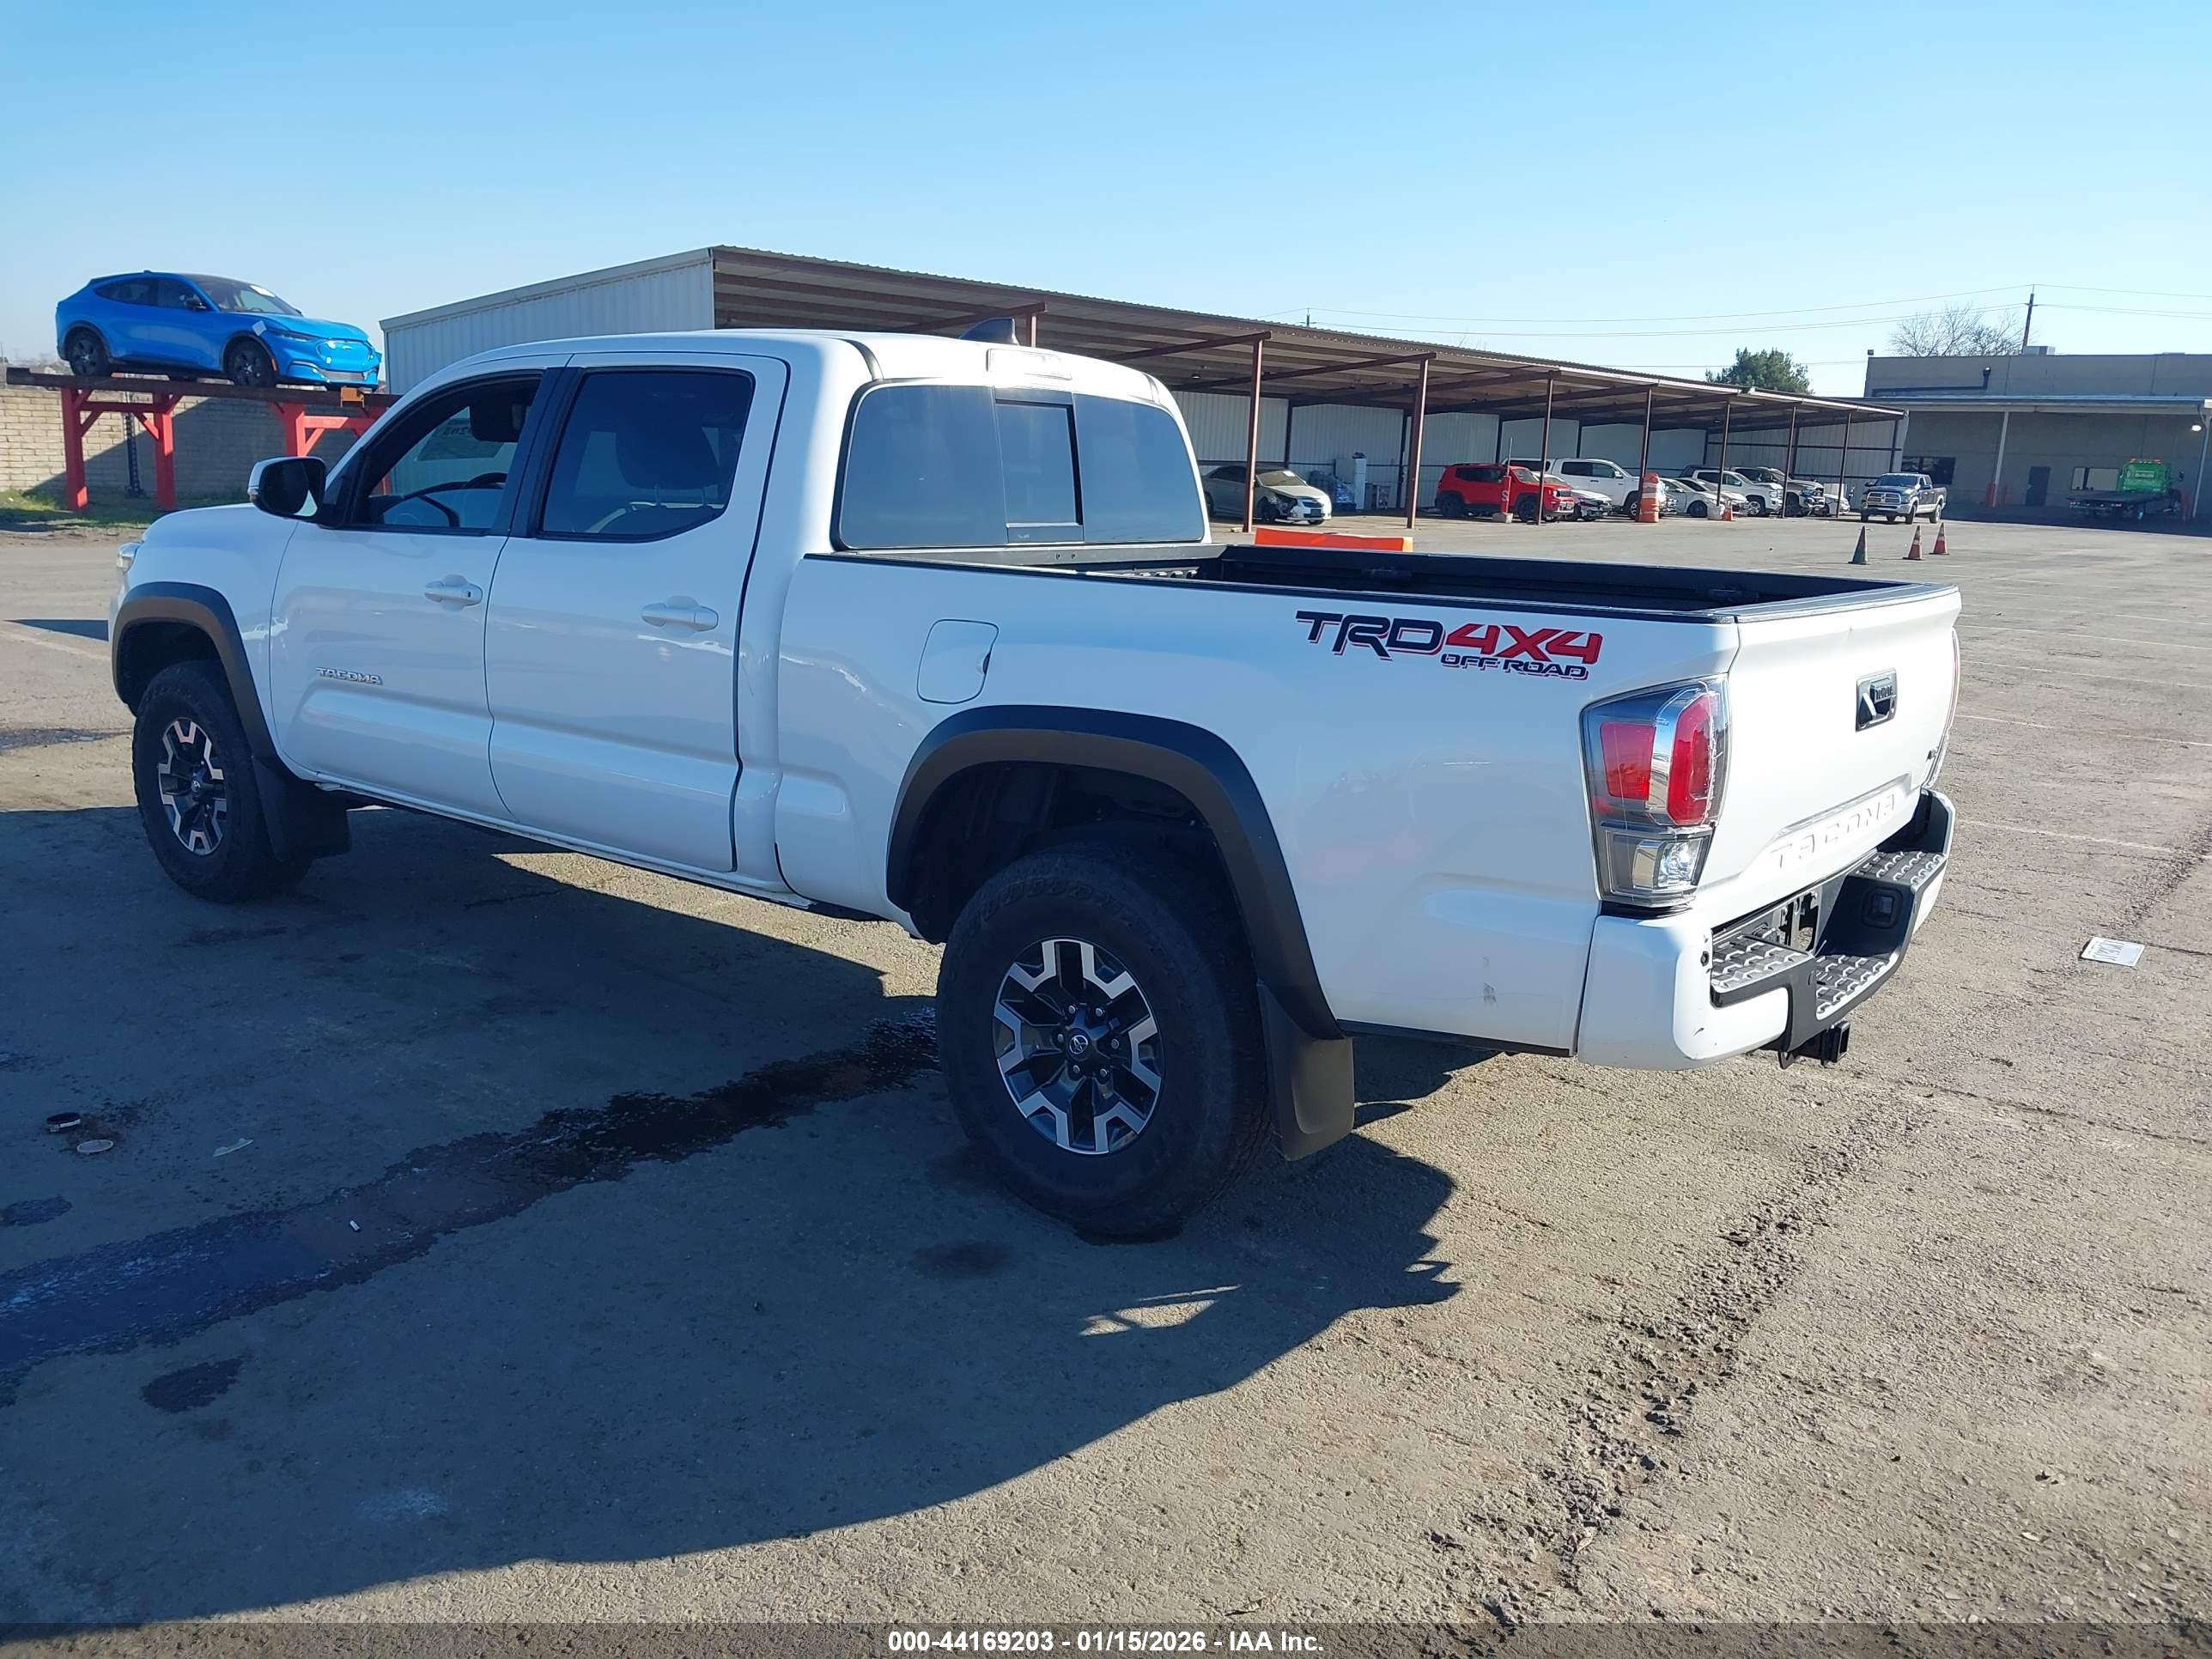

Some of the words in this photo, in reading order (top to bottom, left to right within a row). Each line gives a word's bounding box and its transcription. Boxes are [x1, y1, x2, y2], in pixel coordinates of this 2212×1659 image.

[1296, 611, 1444, 661] TRD
[315, 666, 383, 685] TACOMA
[1440, 653, 1499, 670] OFF
[1502, 660, 1589, 680] ROAD
[1771, 793, 1894, 867] TACOMA
